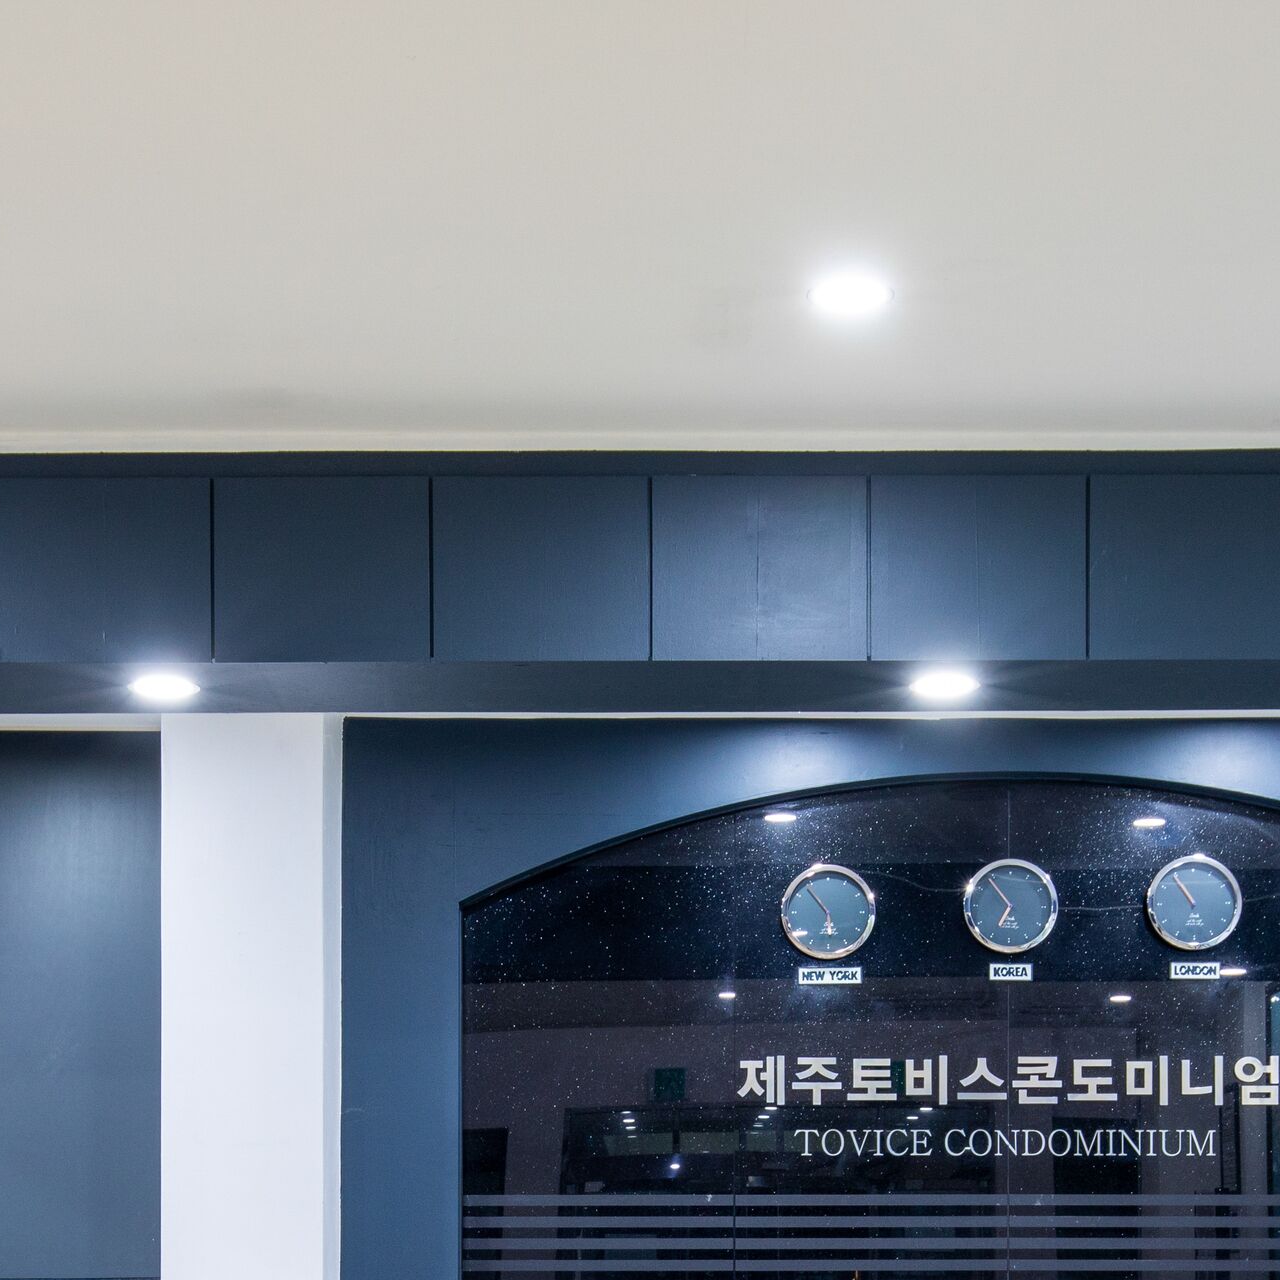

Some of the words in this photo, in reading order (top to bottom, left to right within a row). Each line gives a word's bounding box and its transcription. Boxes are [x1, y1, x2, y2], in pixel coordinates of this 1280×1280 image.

[801, 970, 826, 982] NEW
[829, 970, 859, 982] YORK
[993, 966, 1029, 978] KOREA
[1173, 965, 1218, 976] LONDON
[737, 1054, 1280, 1107] 제주토비스콘도미니엄
[794, 1127, 934, 1157] TOVICE
[944, 1127, 1218, 1157] CONDOMINIUM
